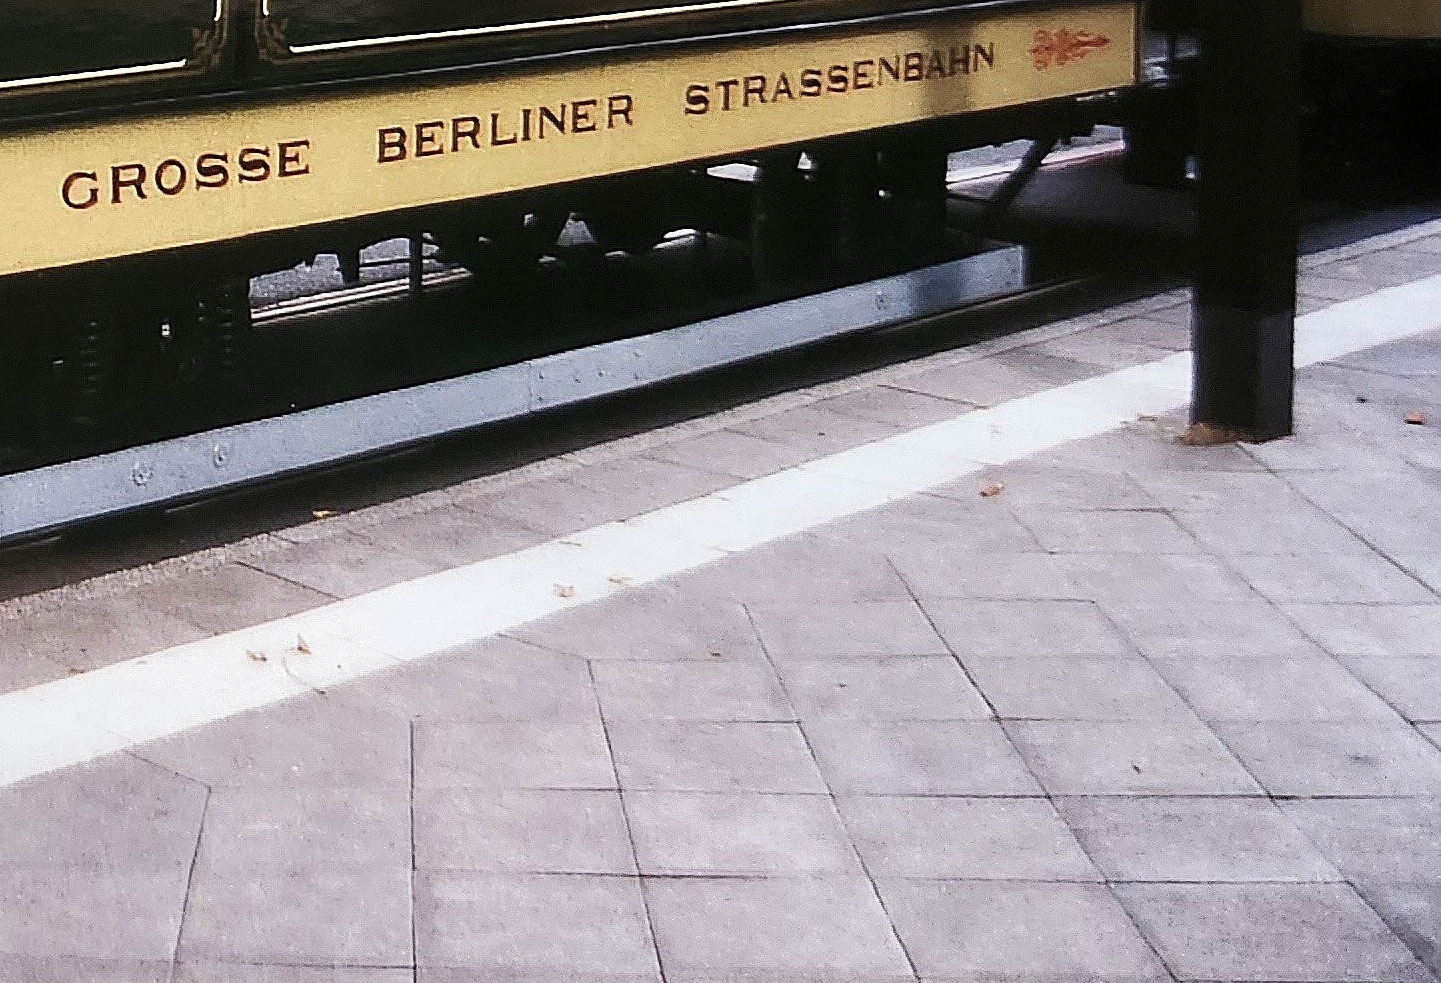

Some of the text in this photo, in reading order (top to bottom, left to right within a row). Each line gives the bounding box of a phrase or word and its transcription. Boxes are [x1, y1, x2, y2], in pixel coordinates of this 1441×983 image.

[61, 41, 997, 210] GROSSE BERLINER STRASSENBAHN
